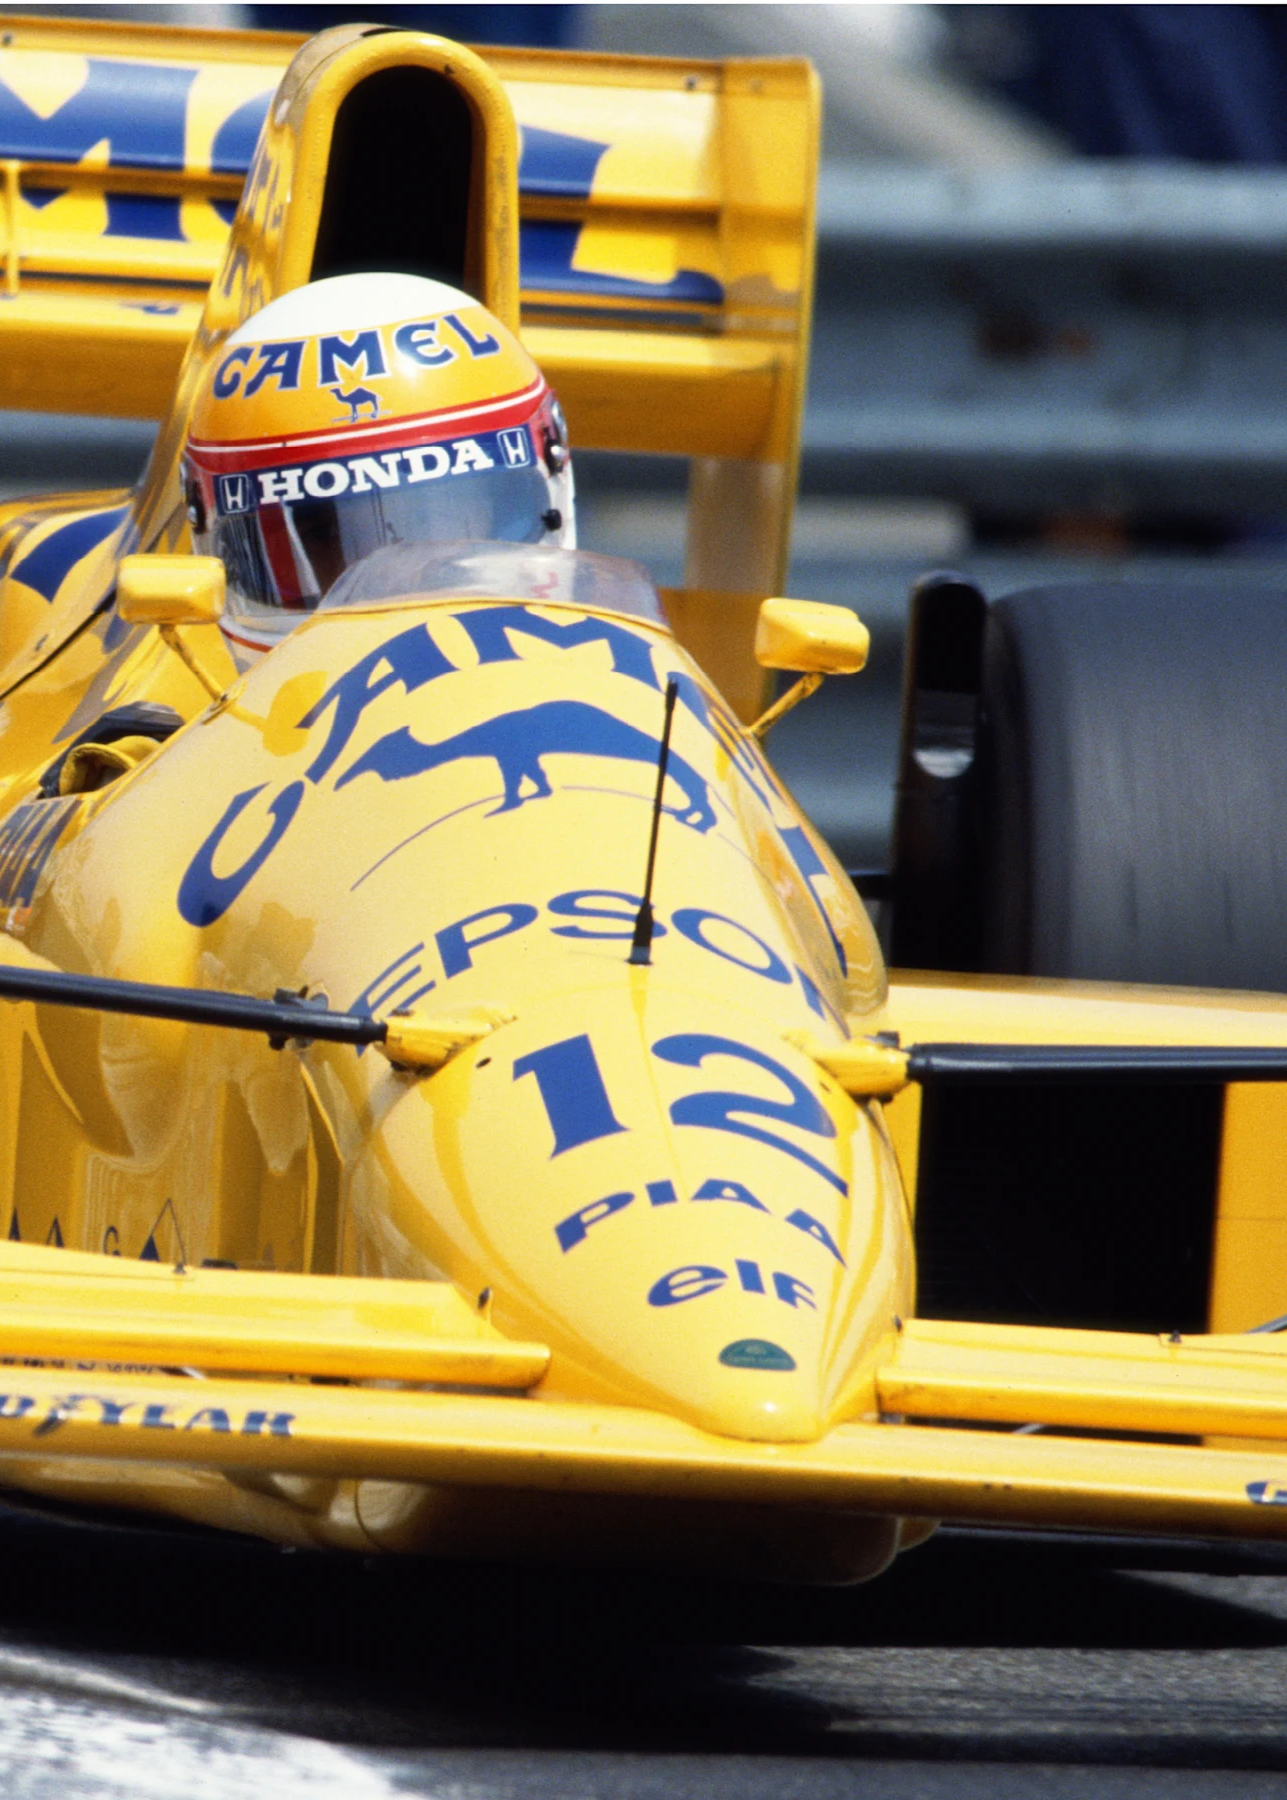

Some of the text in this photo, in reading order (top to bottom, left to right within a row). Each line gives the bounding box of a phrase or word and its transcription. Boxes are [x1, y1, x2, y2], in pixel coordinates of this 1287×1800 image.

[212, 313, 500, 399] CAMEL
[258, 437, 494, 504] HONDA
[512, 1033, 849, 1199] 12
[554, 1178, 845, 1268] PIAA
